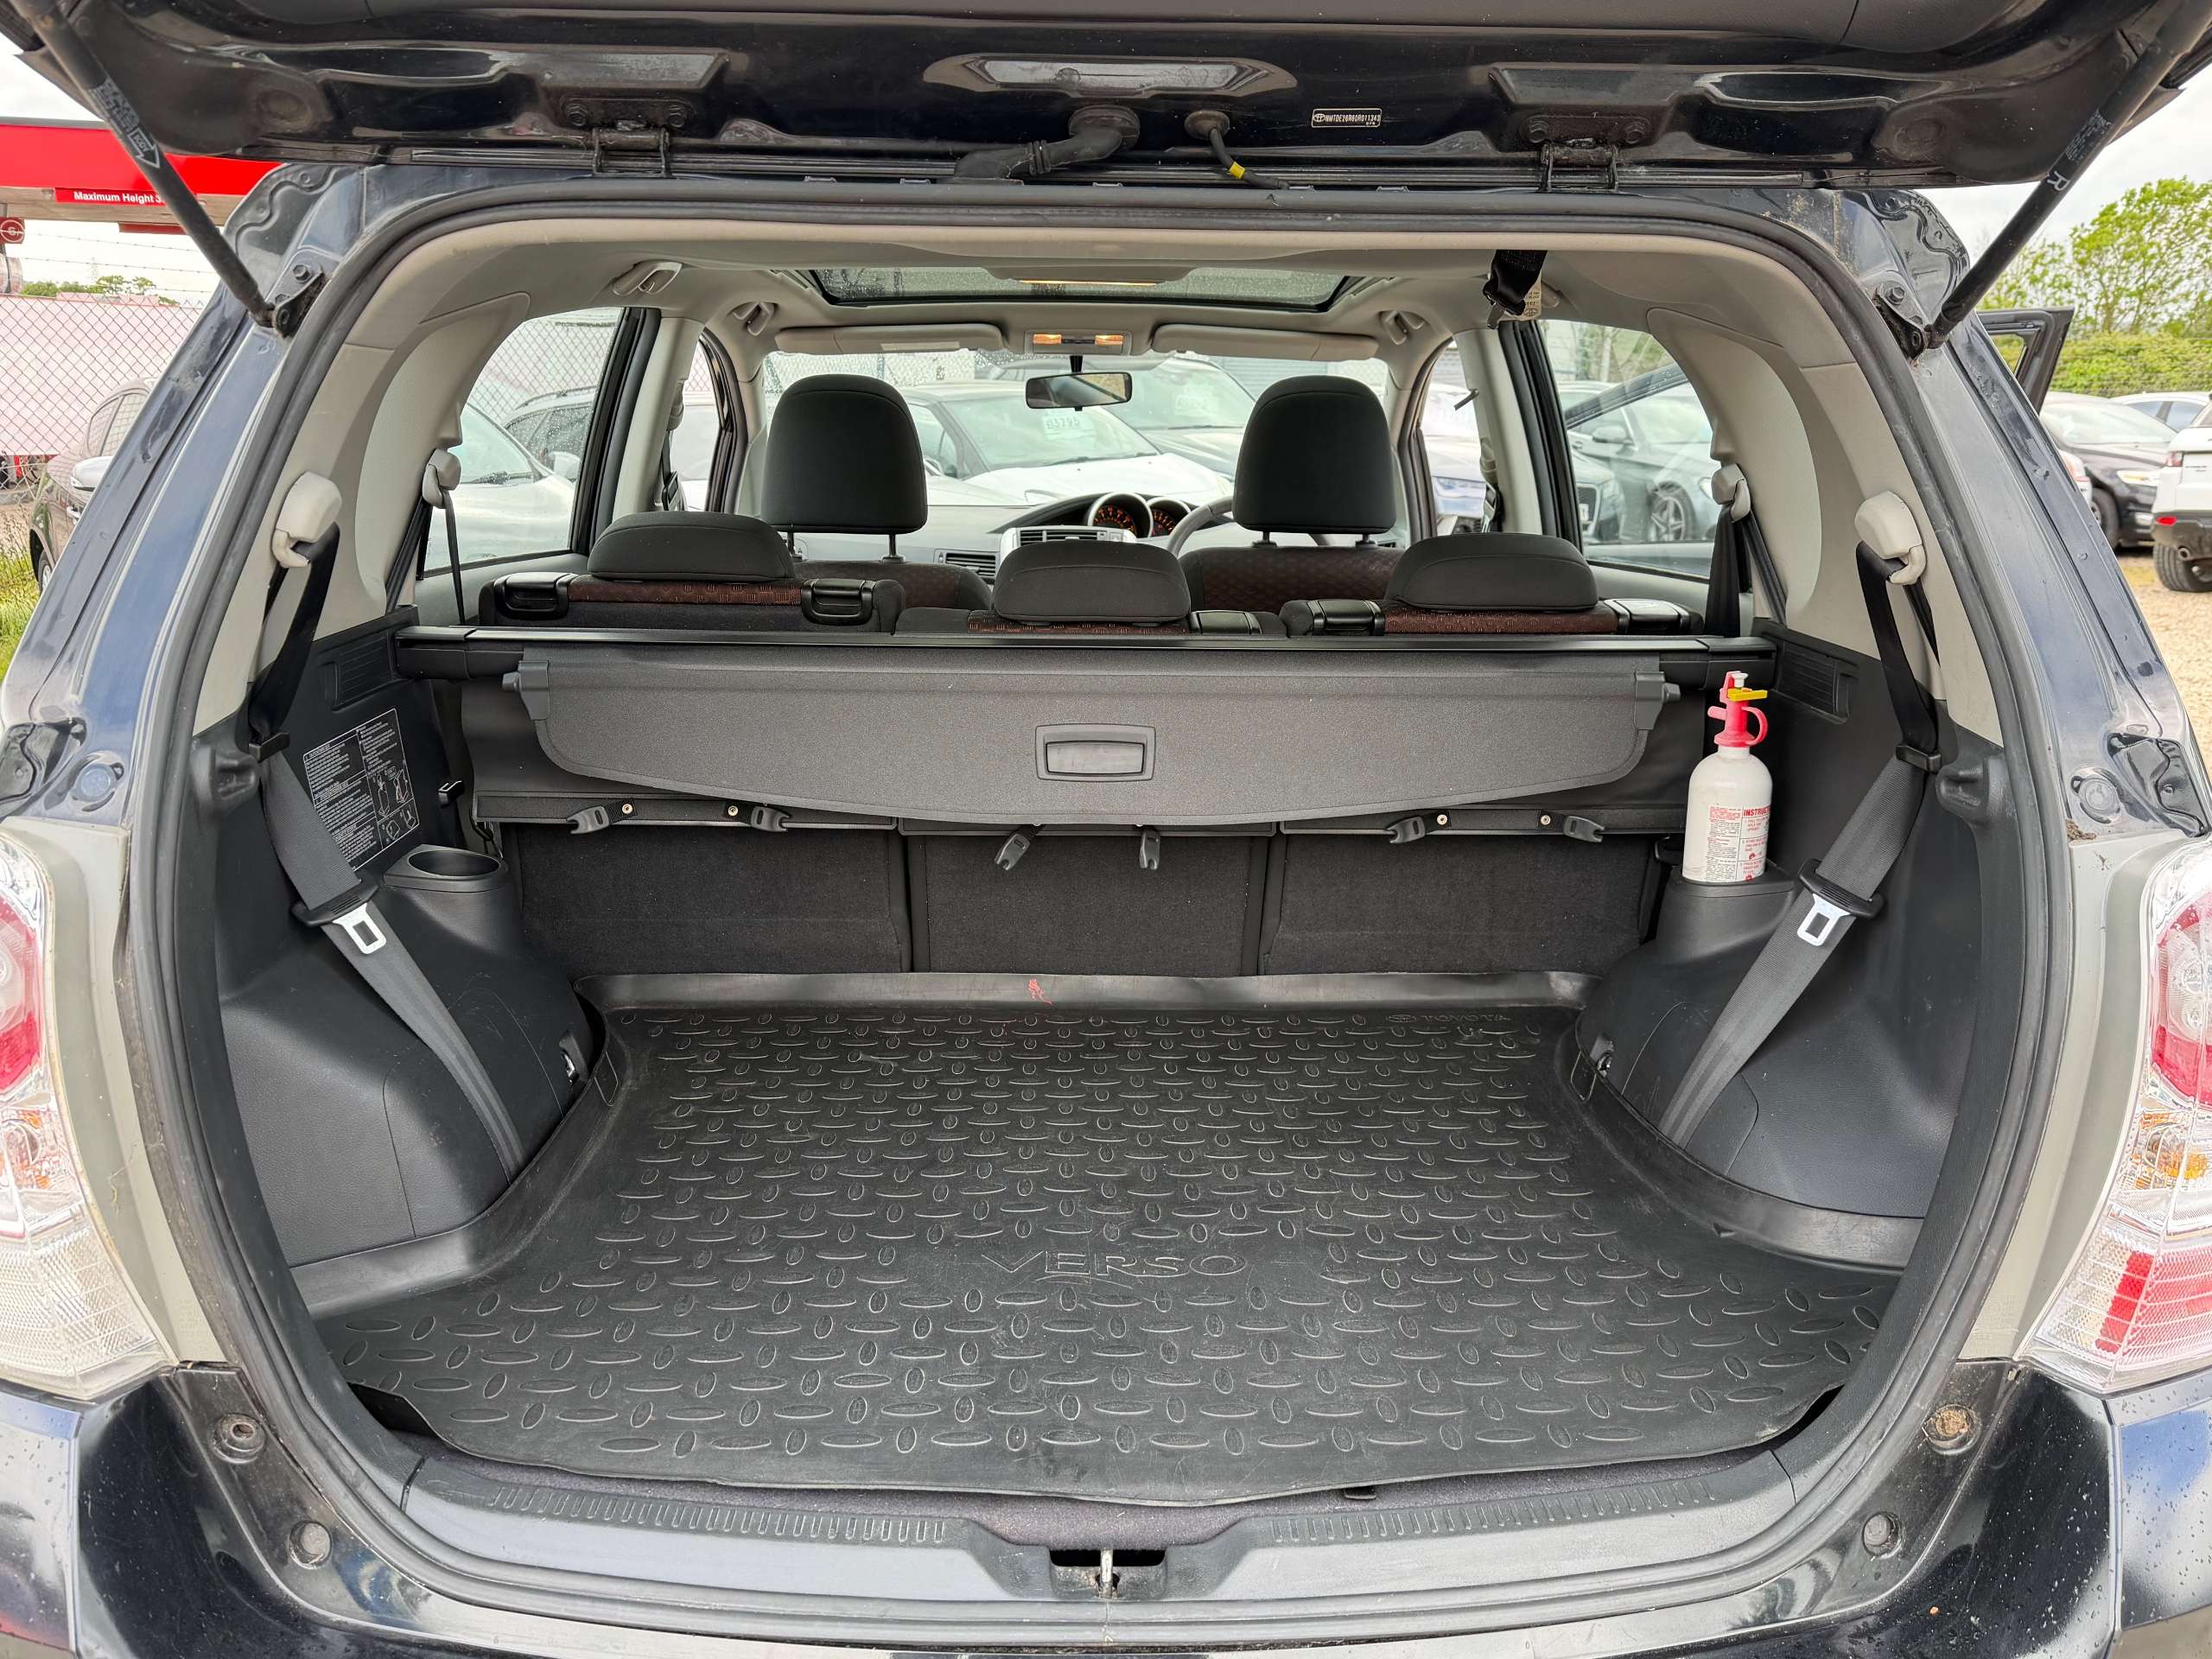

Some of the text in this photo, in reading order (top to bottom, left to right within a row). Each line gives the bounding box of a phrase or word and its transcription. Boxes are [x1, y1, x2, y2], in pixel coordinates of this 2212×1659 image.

[2047, 171, 2070, 191] R
[73, 191, 120, 201] Maximum
[122, 193, 154, 205] Height
[982, 1250, 1249, 1277] VERSO
